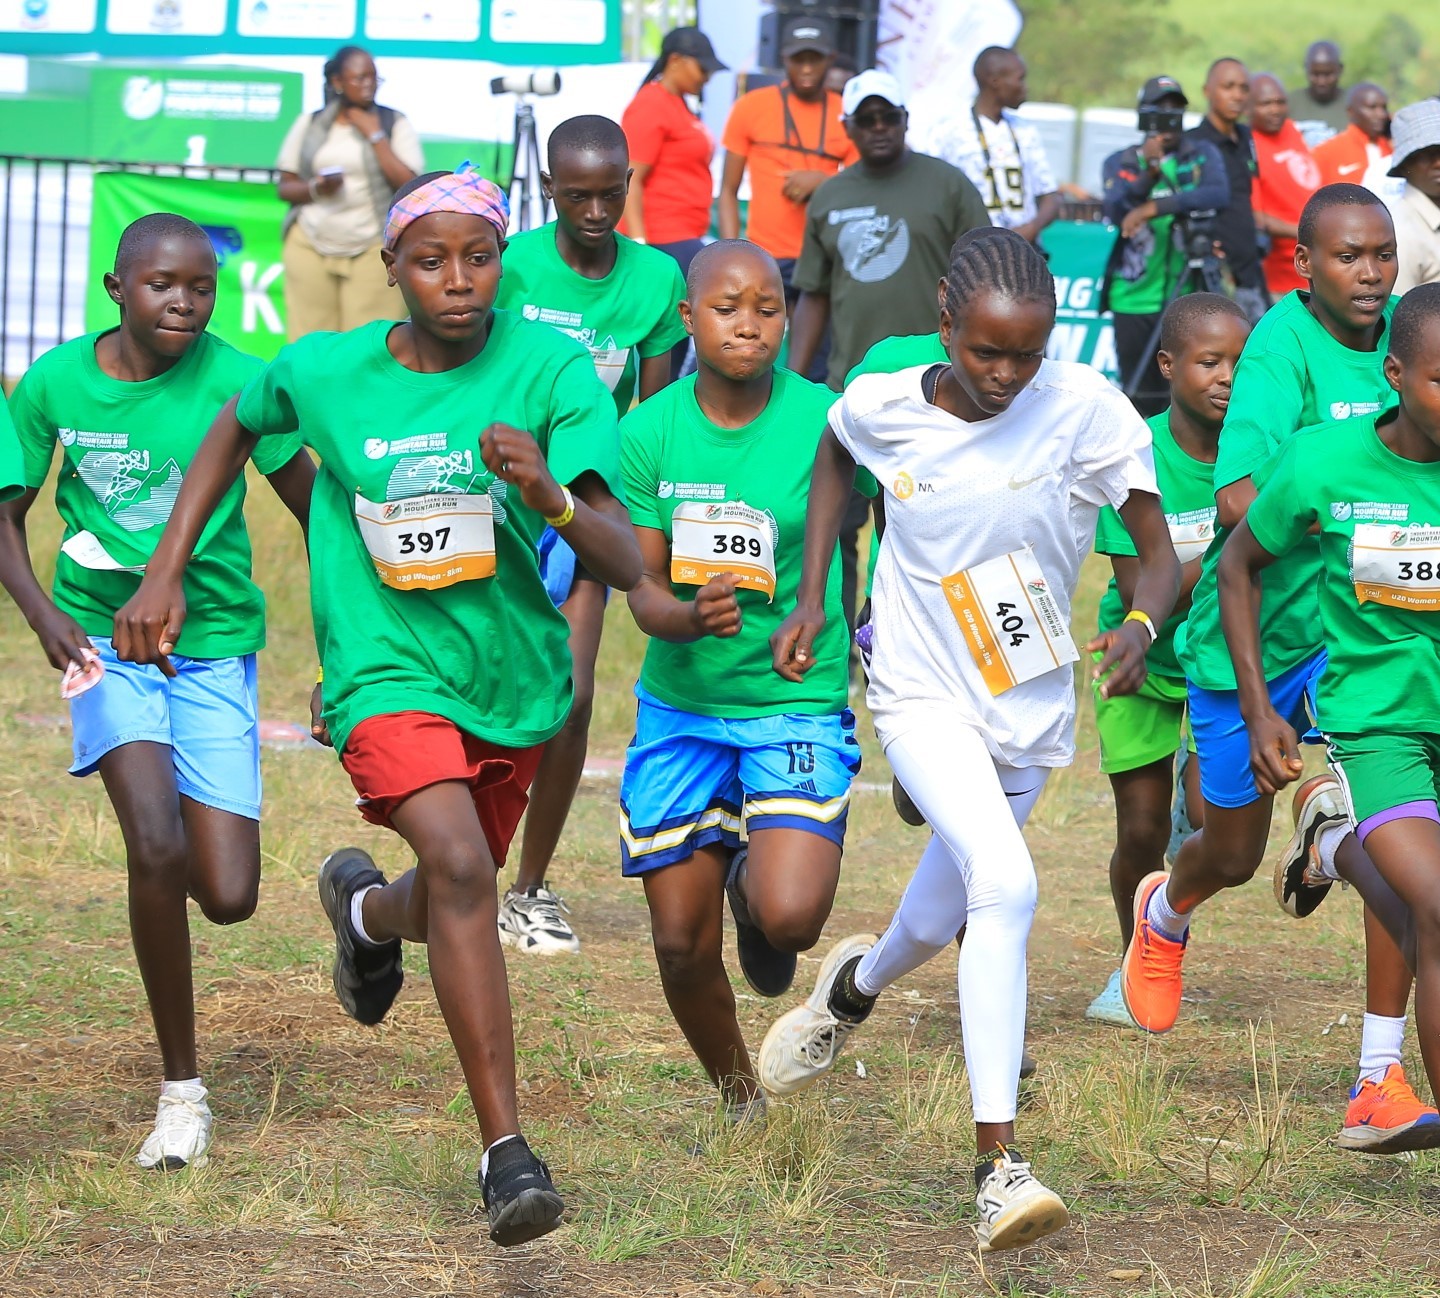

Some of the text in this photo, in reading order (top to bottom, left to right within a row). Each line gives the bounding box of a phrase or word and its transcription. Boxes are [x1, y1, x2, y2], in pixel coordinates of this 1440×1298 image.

[983, 167, 1024, 210] 19
[429, 438, 447, 447] RUN
[404, 502, 440, 512] MOUNTAIN
[724, 511, 754, 519] MOUNTAIN
[1353, 508, 1408, 517] MOUNTAIN RUN
[398, 527, 451, 554] 397
[713, 534, 761, 558] 389
[1391, 594, 1406, 602] U20
[996, 602, 1030, 647] 404
[1038, 597, 1054, 624] MOUNTAIN
[1051, 625, 1060, 637] RUN
[962, 609, 974, 623] U20
[969, 623, 986, 650] Women
